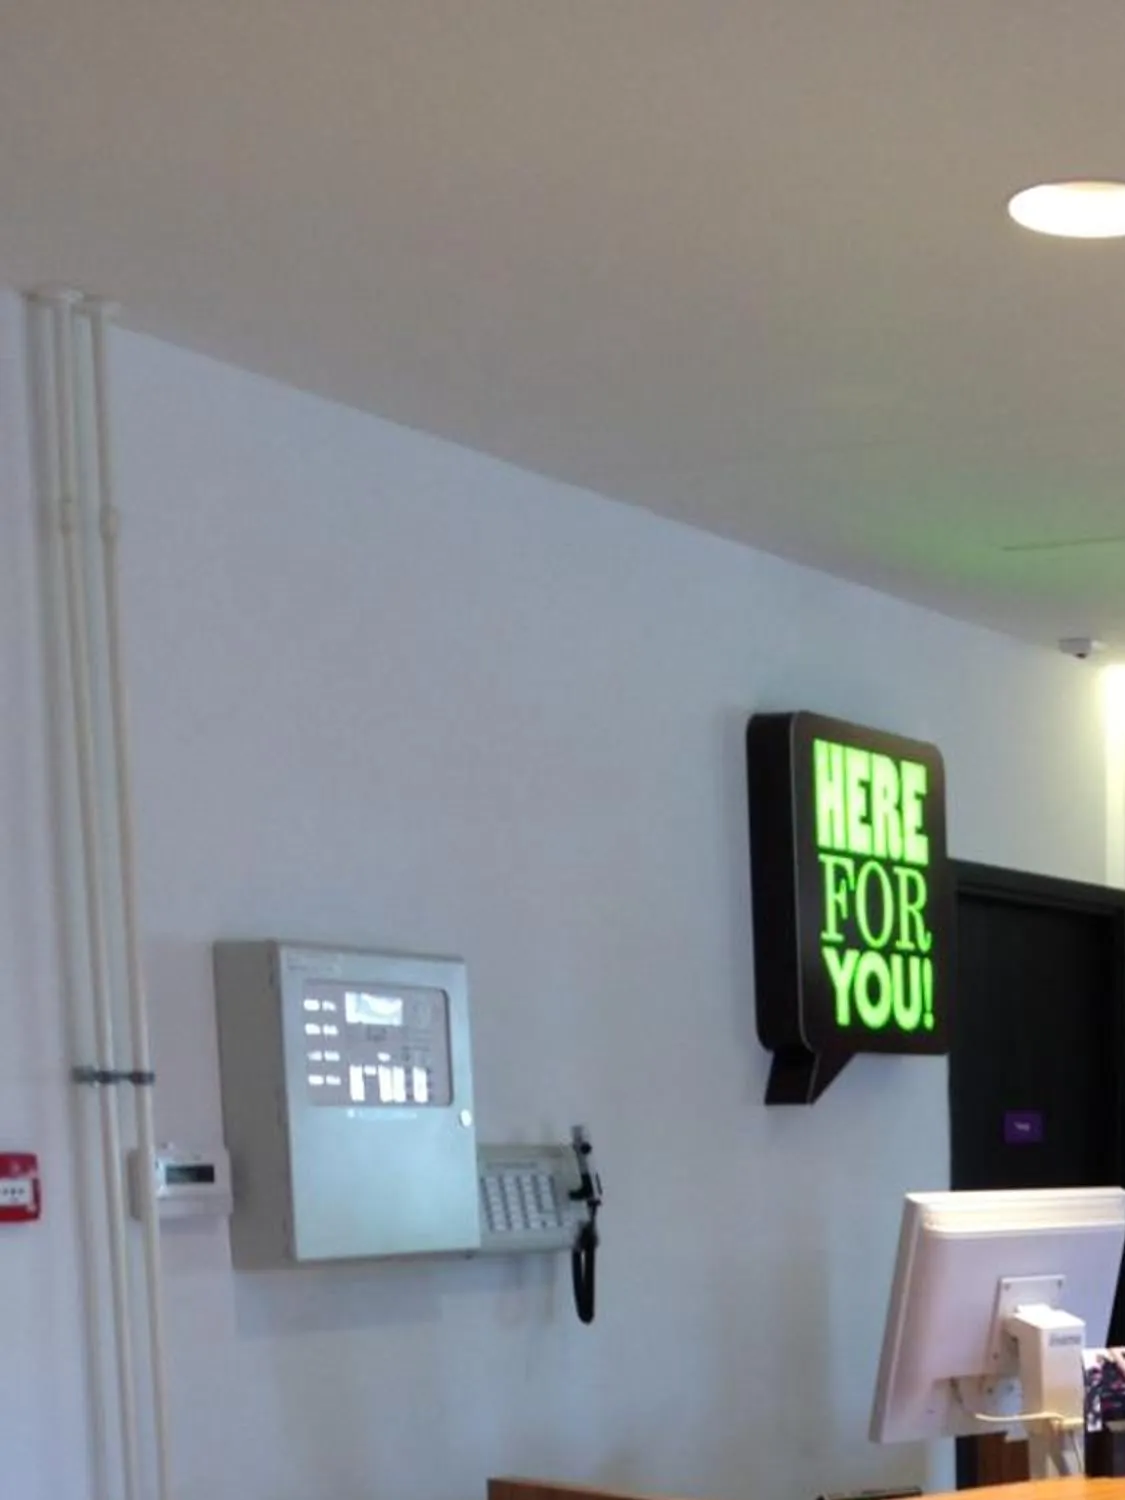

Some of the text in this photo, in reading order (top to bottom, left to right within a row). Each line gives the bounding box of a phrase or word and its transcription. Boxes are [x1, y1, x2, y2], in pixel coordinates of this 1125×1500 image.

[813, 738, 929, 867] HERE
[818, 853, 932, 953] FOR
[821, 946, 935, 1031] YOU!
